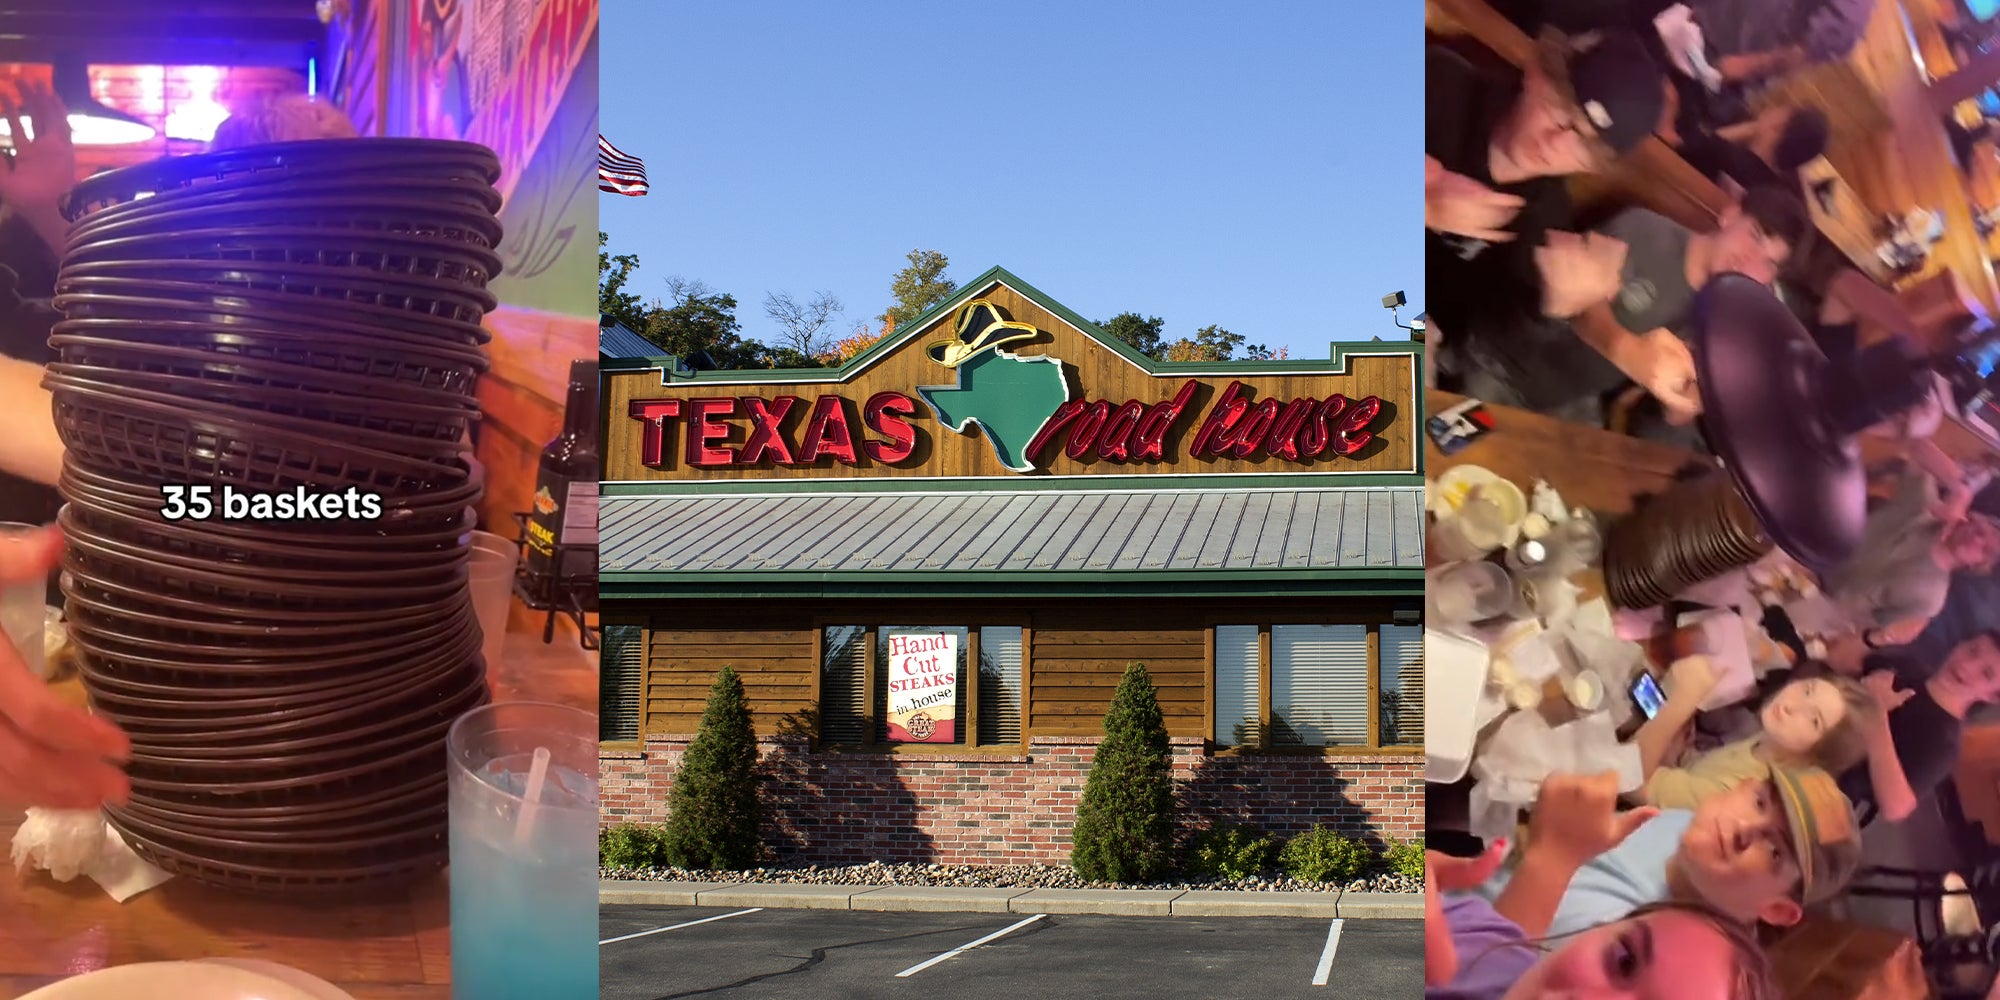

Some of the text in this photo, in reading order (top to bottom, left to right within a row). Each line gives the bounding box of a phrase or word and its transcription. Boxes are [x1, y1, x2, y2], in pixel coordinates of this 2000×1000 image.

[628, 379, 1381, 466] TEXAS road house
[889, 631, 949, 657] Hand
[903, 654, 941, 676] Cut
[889, 673, 956, 693] STEAKS
[896, 687, 953, 716] in house
